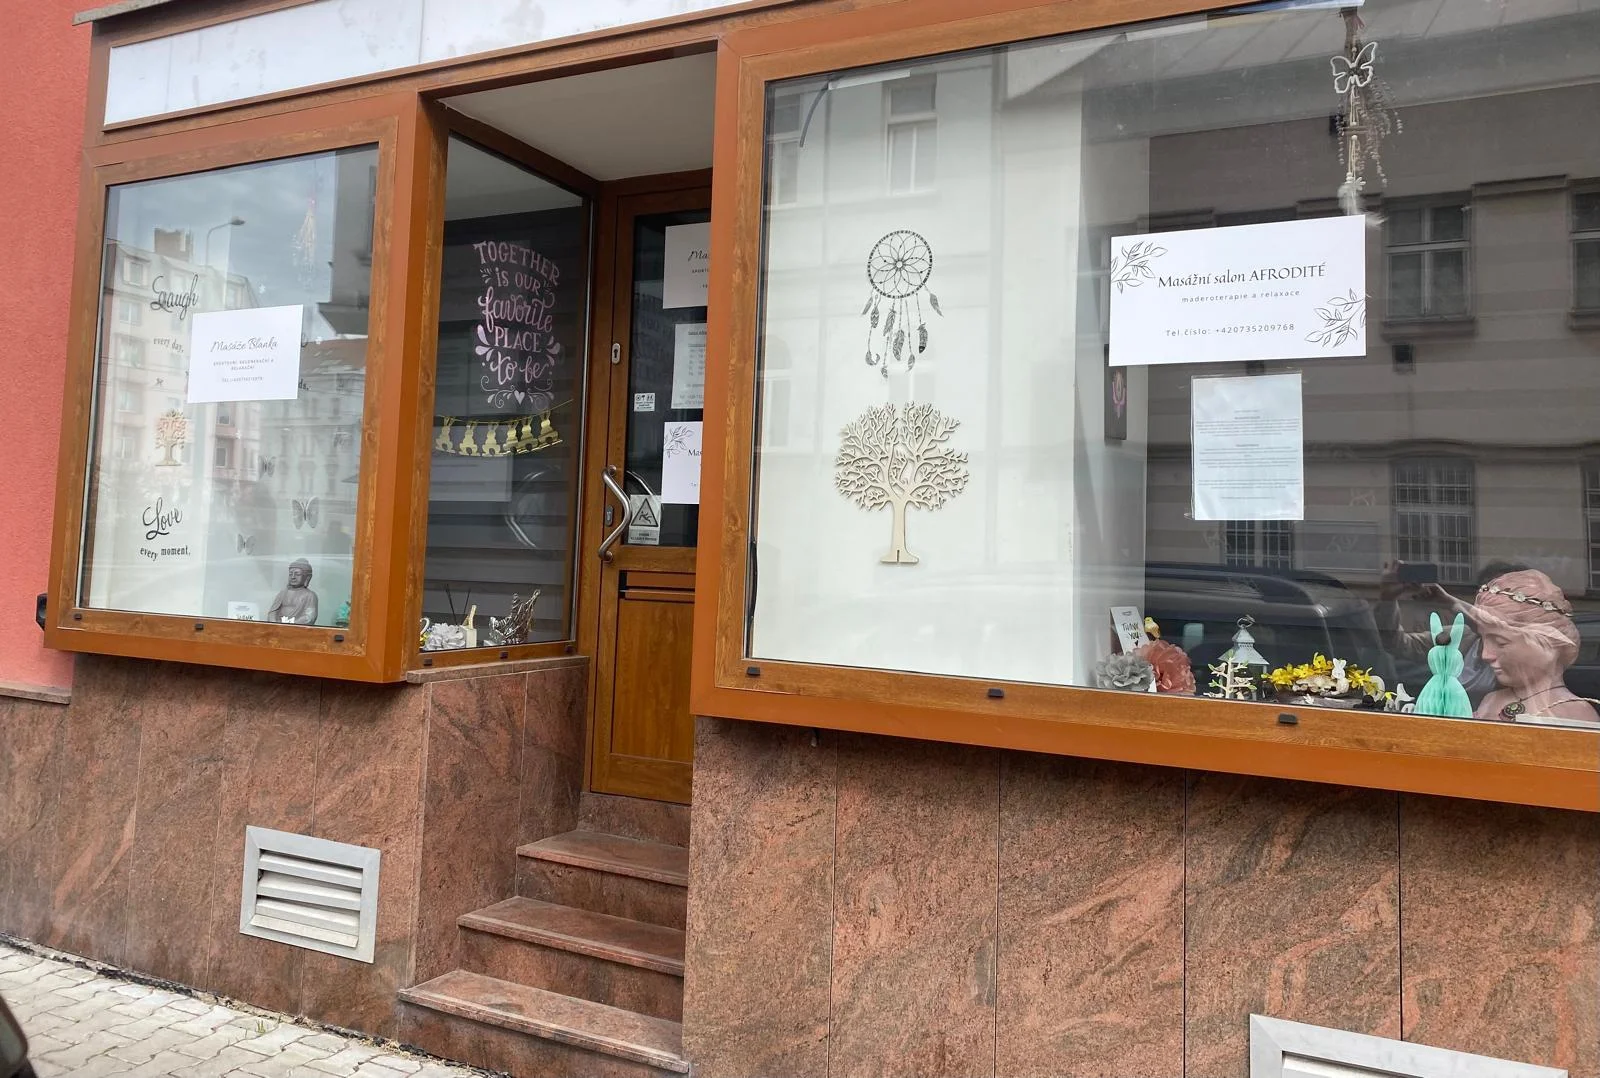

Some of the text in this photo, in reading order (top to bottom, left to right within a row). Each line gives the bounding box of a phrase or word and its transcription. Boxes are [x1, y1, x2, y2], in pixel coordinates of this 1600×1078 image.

[473, 241, 560, 286] TOGETHER
[1158, 262, 1327, 288] Masážní salon AFRODITÉ
[515, 272, 541, 295] OUR
[1181, 292, 1248, 304] maderoterapie
[1260, 289, 1301, 299] relaxace
[150, 274, 199, 321] Laugh
[478, 286, 555, 333] favorite
[247, 336, 279, 351] Blanka
[494, 326, 542, 352] PLACE
[490, 351, 550, 385] to be
[142, 496, 183, 540] Love
[140, 547, 158, 562] every
